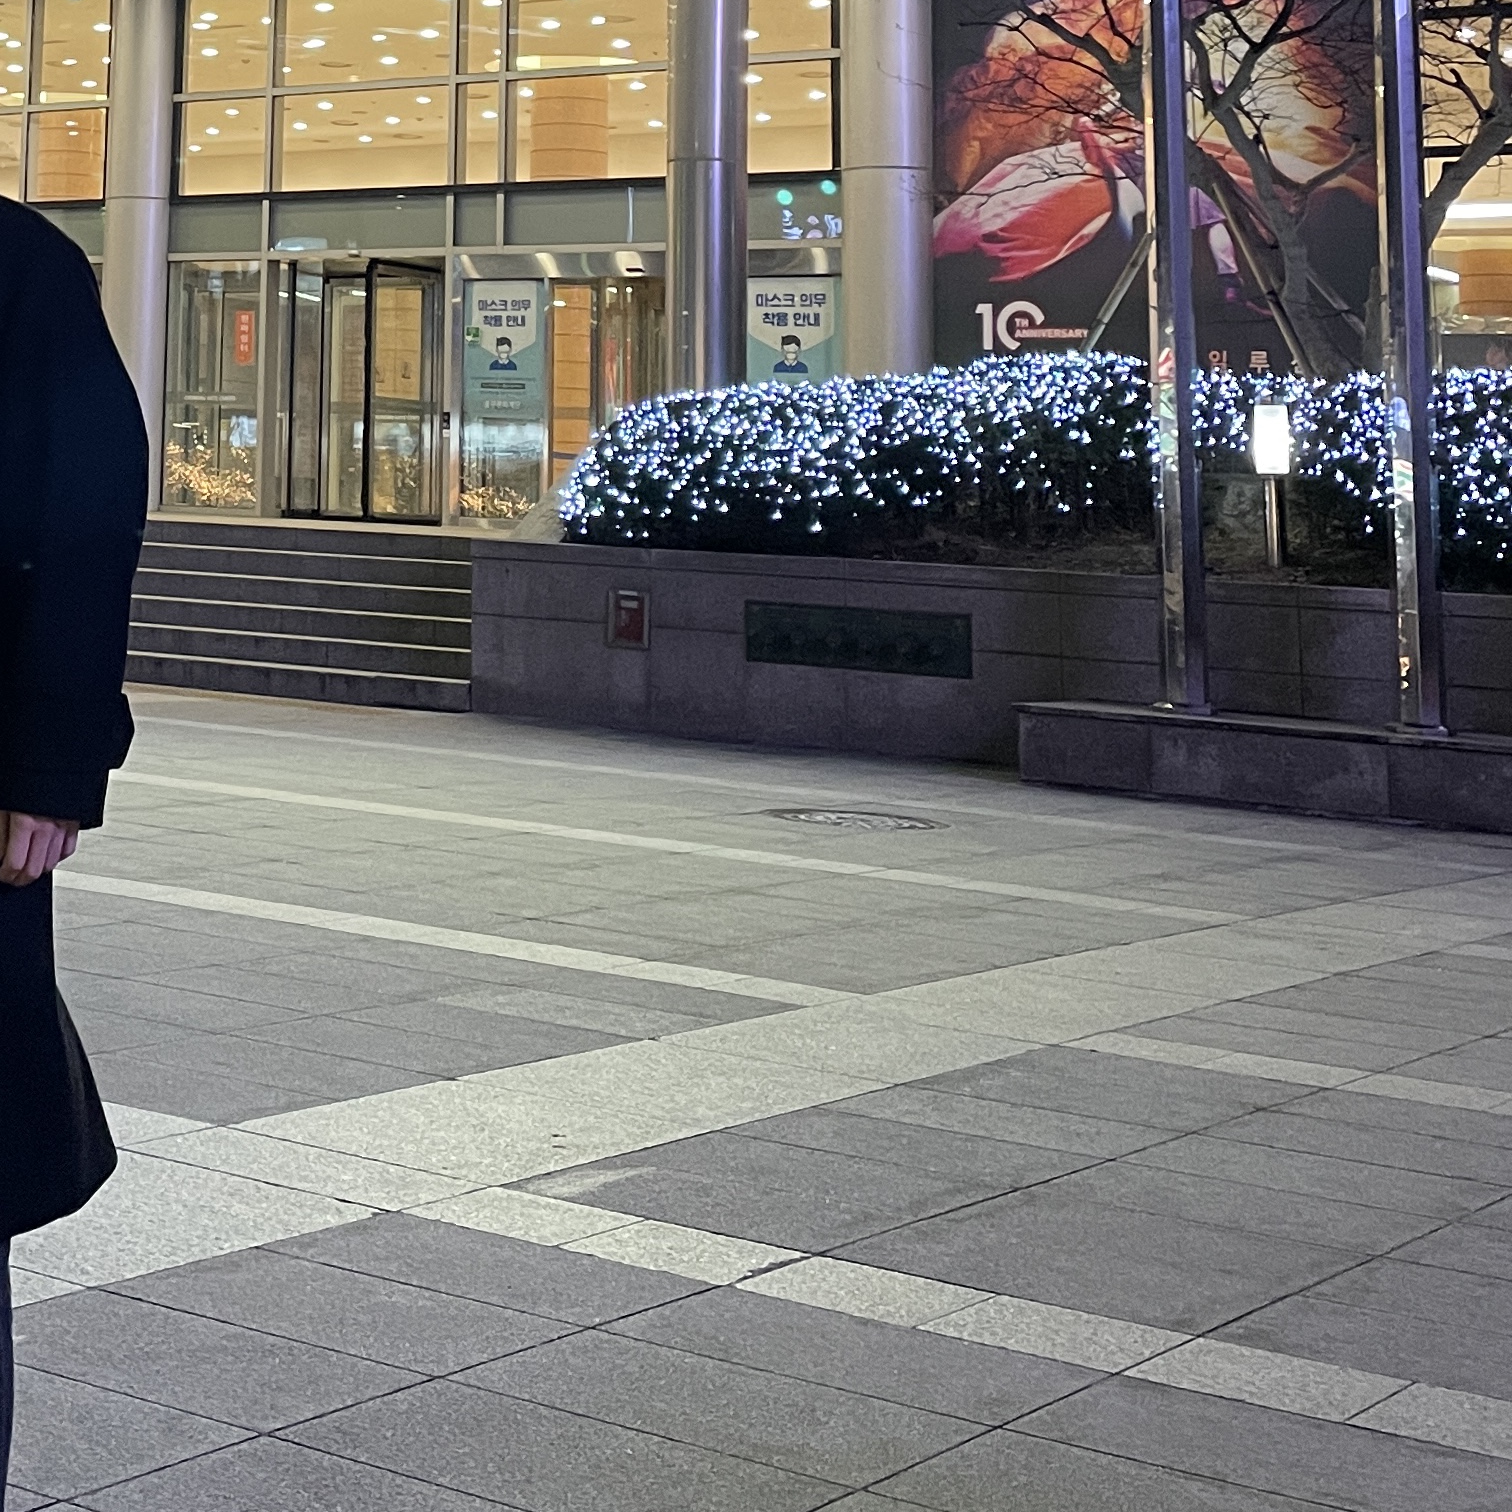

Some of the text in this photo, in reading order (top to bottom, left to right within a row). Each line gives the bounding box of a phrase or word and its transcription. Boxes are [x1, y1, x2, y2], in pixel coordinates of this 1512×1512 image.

[477, 299, 531, 311] 마스크 의무
[755, 293, 826, 307] 마스크 의무
[483, 315, 526, 327] 착용 안내
[762, 312, 821, 327] 착용 안내
[1014, 329, 1088, 338] ANNIVERSARY
